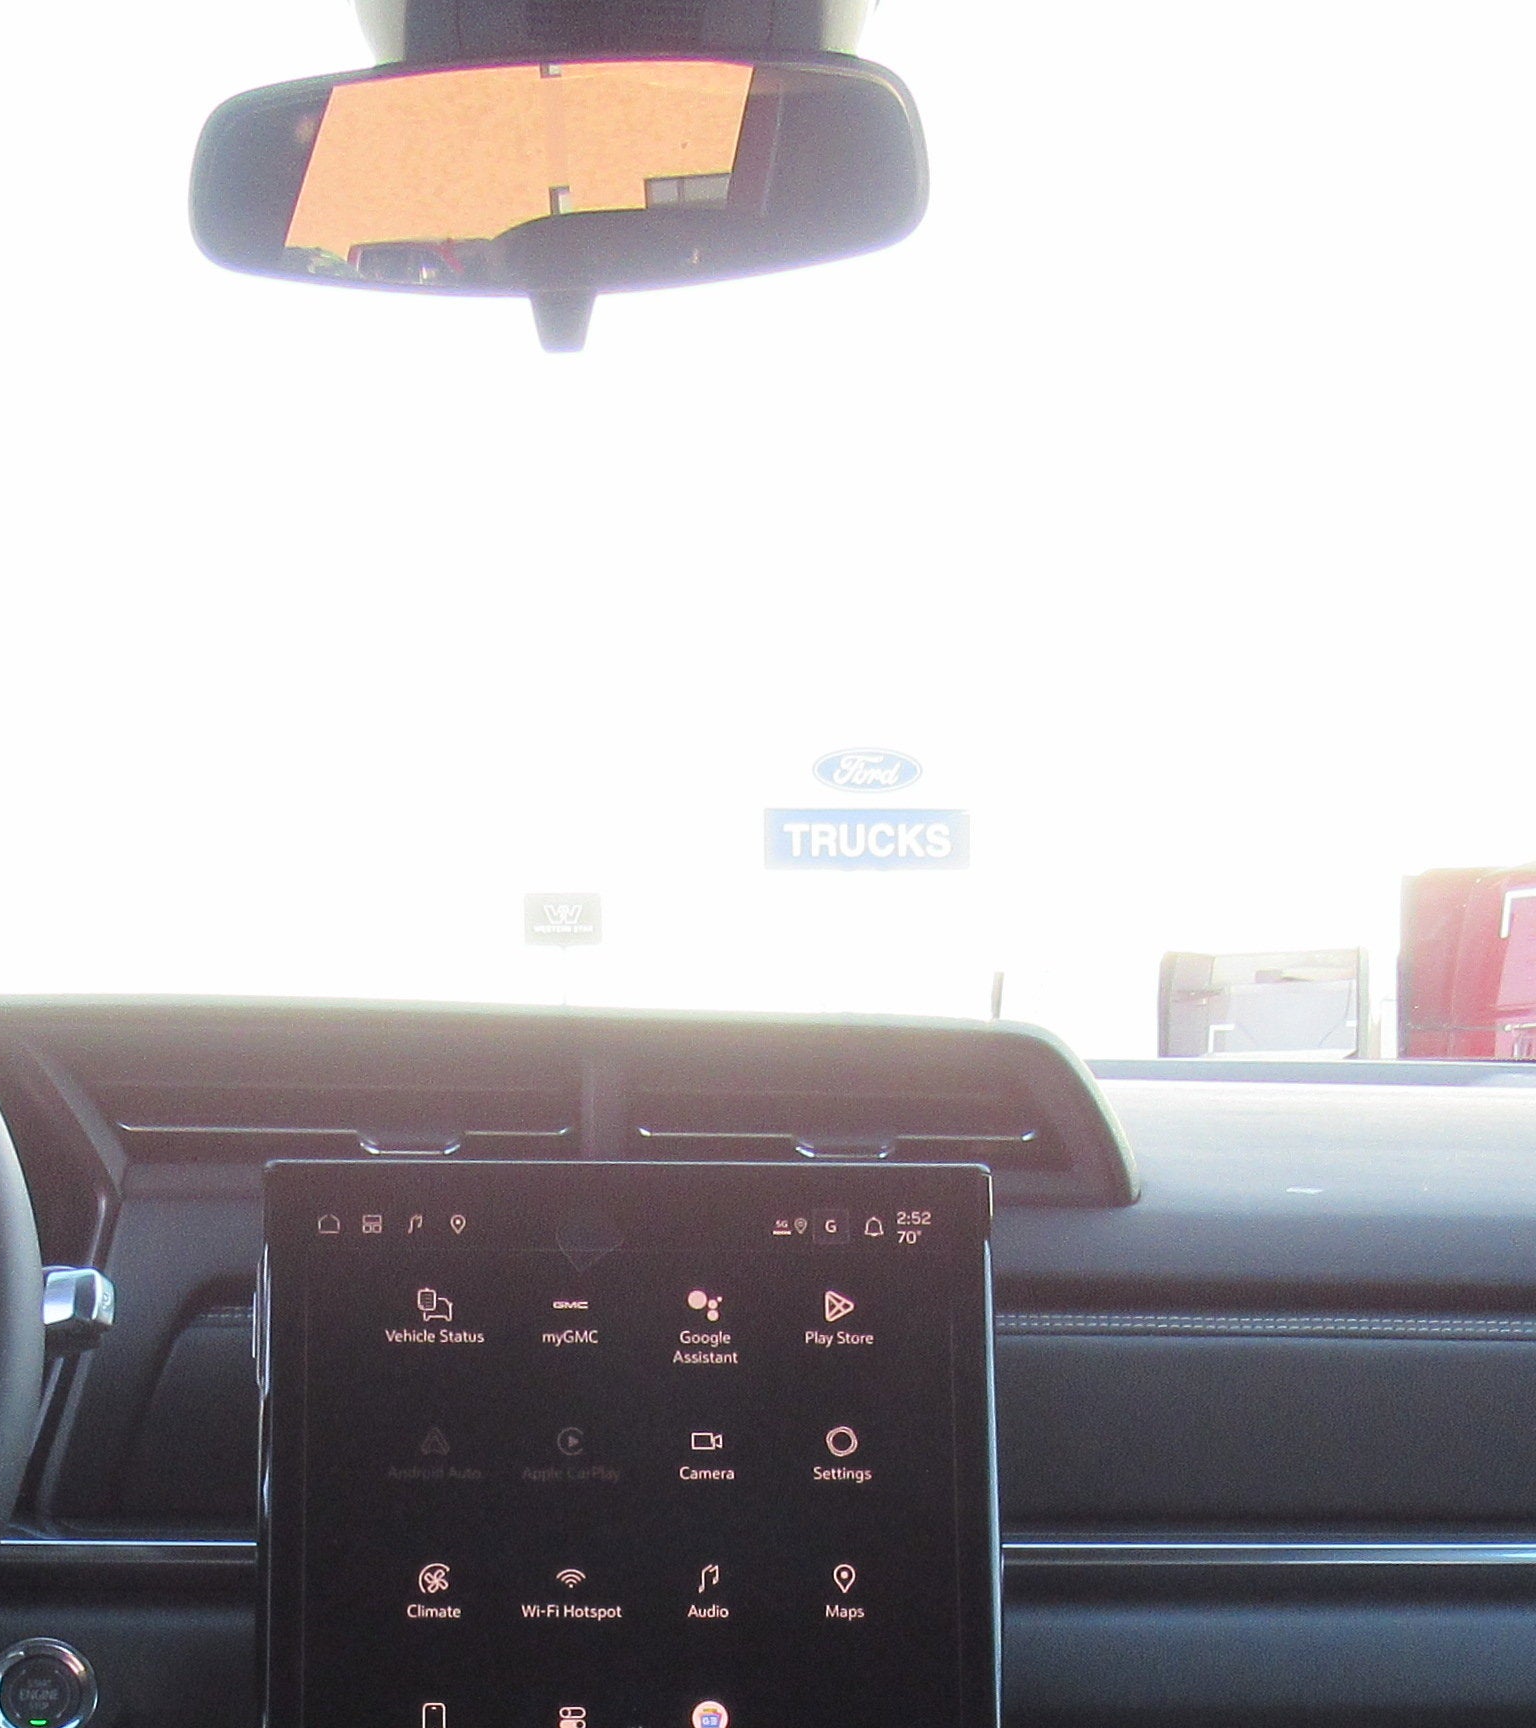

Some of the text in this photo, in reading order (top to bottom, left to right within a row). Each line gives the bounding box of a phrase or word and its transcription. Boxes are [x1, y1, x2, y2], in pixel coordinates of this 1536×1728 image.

[832, 755, 902, 785] Ford
[782, 822, 954, 859] TRUCKS
[824, 1219, 838, 1234] G
[896, 1211, 932, 1226] 2:52
[552, 1300, 589, 1310] GMC
[384, 1329, 485, 1344] Vehicle Status
[541, 1329, 599, 1347] myGMC
[679, 1329, 731, 1348] Google
[804, 1330, 875, 1348] Play Store
[672, 1350, 738, 1365] Assistant
[678, 1465, 735, 1482] Camera
[812, 1464, 872, 1484] Settings
[406, 1604, 462, 1619] Climate
[521, 1604, 622, 1622] Wi-Fi Hotspot
[687, 1604, 729, 1619] Audio
[825, 1604, 865, 1622] Maps
